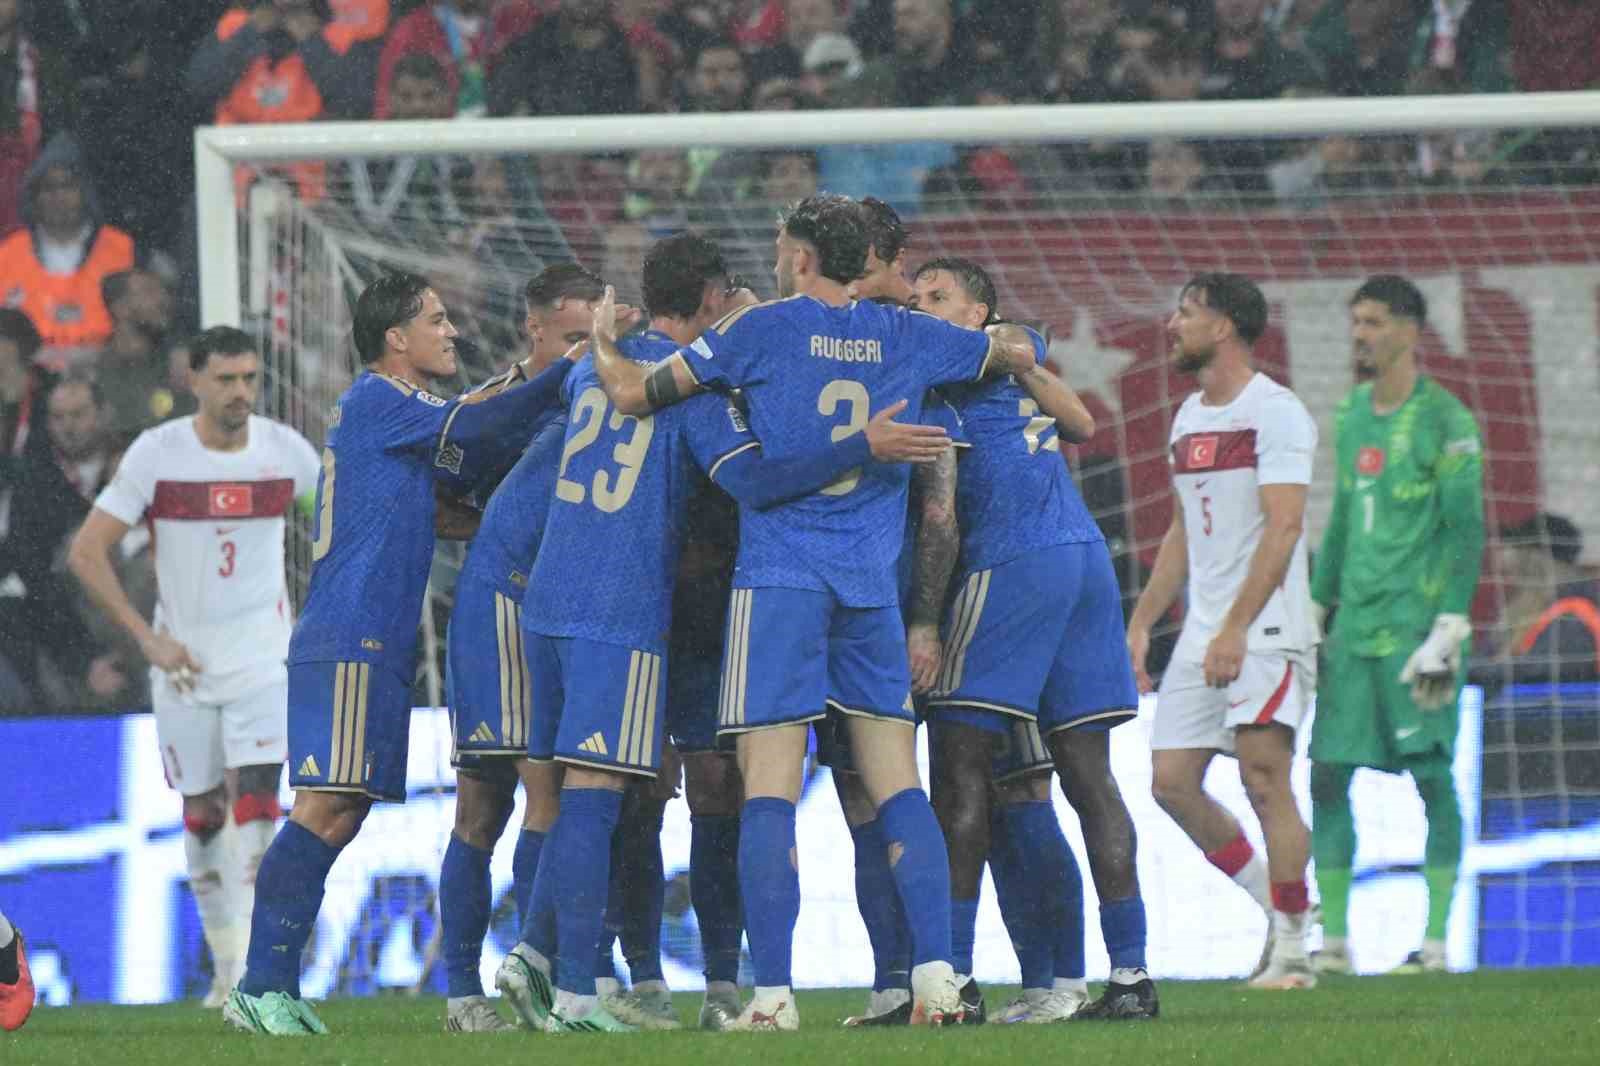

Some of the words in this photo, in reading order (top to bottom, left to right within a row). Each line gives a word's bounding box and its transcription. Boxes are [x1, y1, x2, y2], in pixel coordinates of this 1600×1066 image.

[810, 334, 882, 364] RUGGERI
[555, 386, 655, 513] 23
[1200, 495, 1213, 537] 5
[1362, 494, 1375, 534] 1
[218, 541, 236, 577] 3
